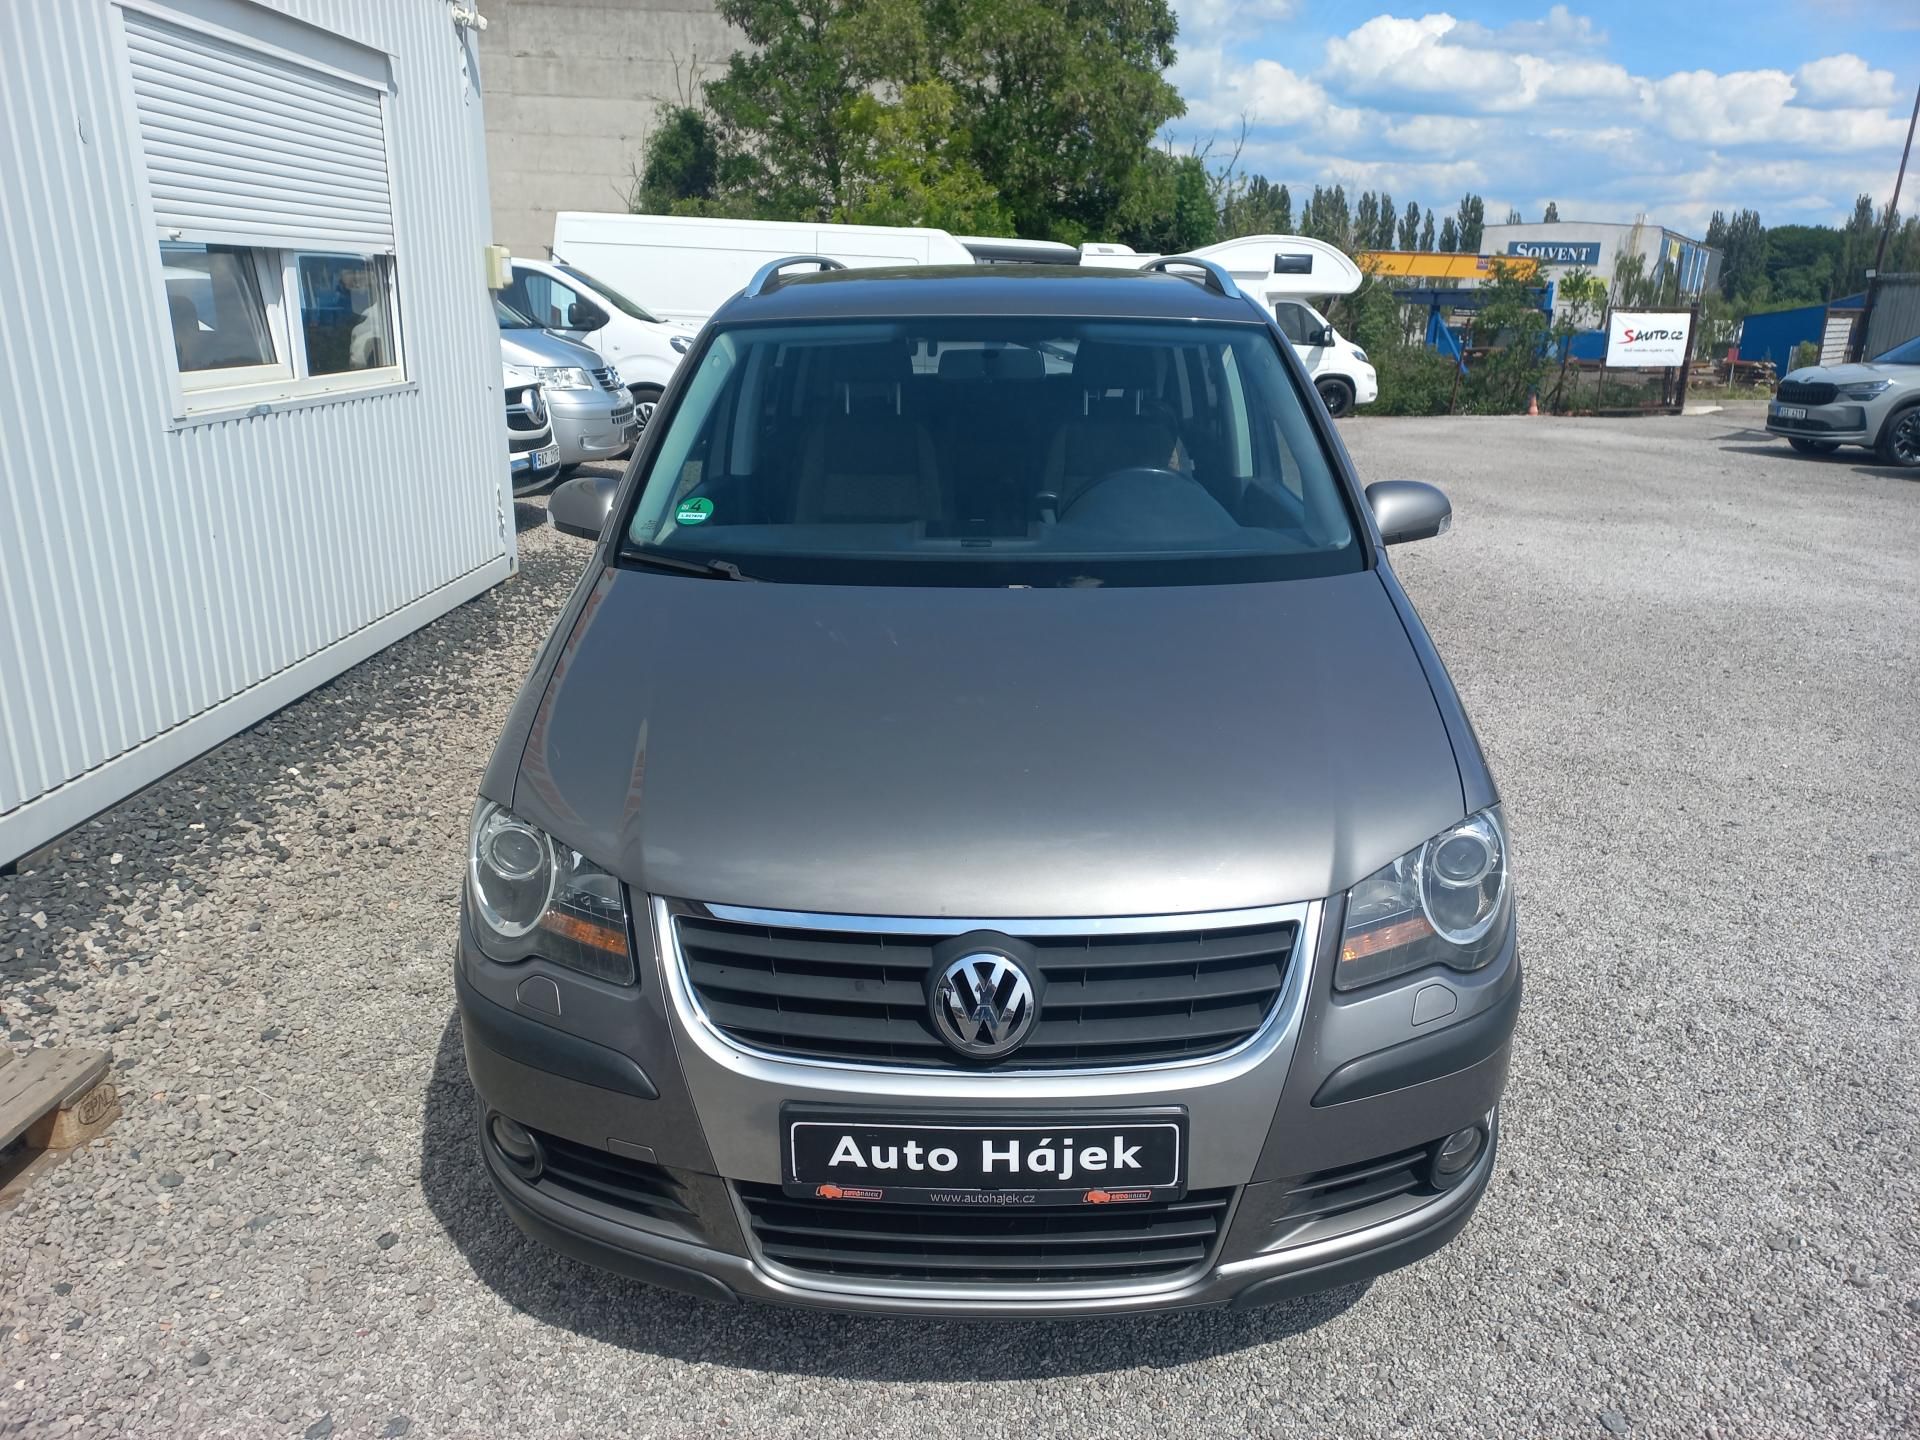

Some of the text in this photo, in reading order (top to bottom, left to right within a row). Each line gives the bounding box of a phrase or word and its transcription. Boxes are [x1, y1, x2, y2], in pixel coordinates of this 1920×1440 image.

[1516, 243, 1590, 261] SOLVENT
[690, 499, 702, 511] 4
[828, 1135, 1143, 1181] Auto Hájek
[930, 1193, 1035, 1206] www.autohajek.cz
